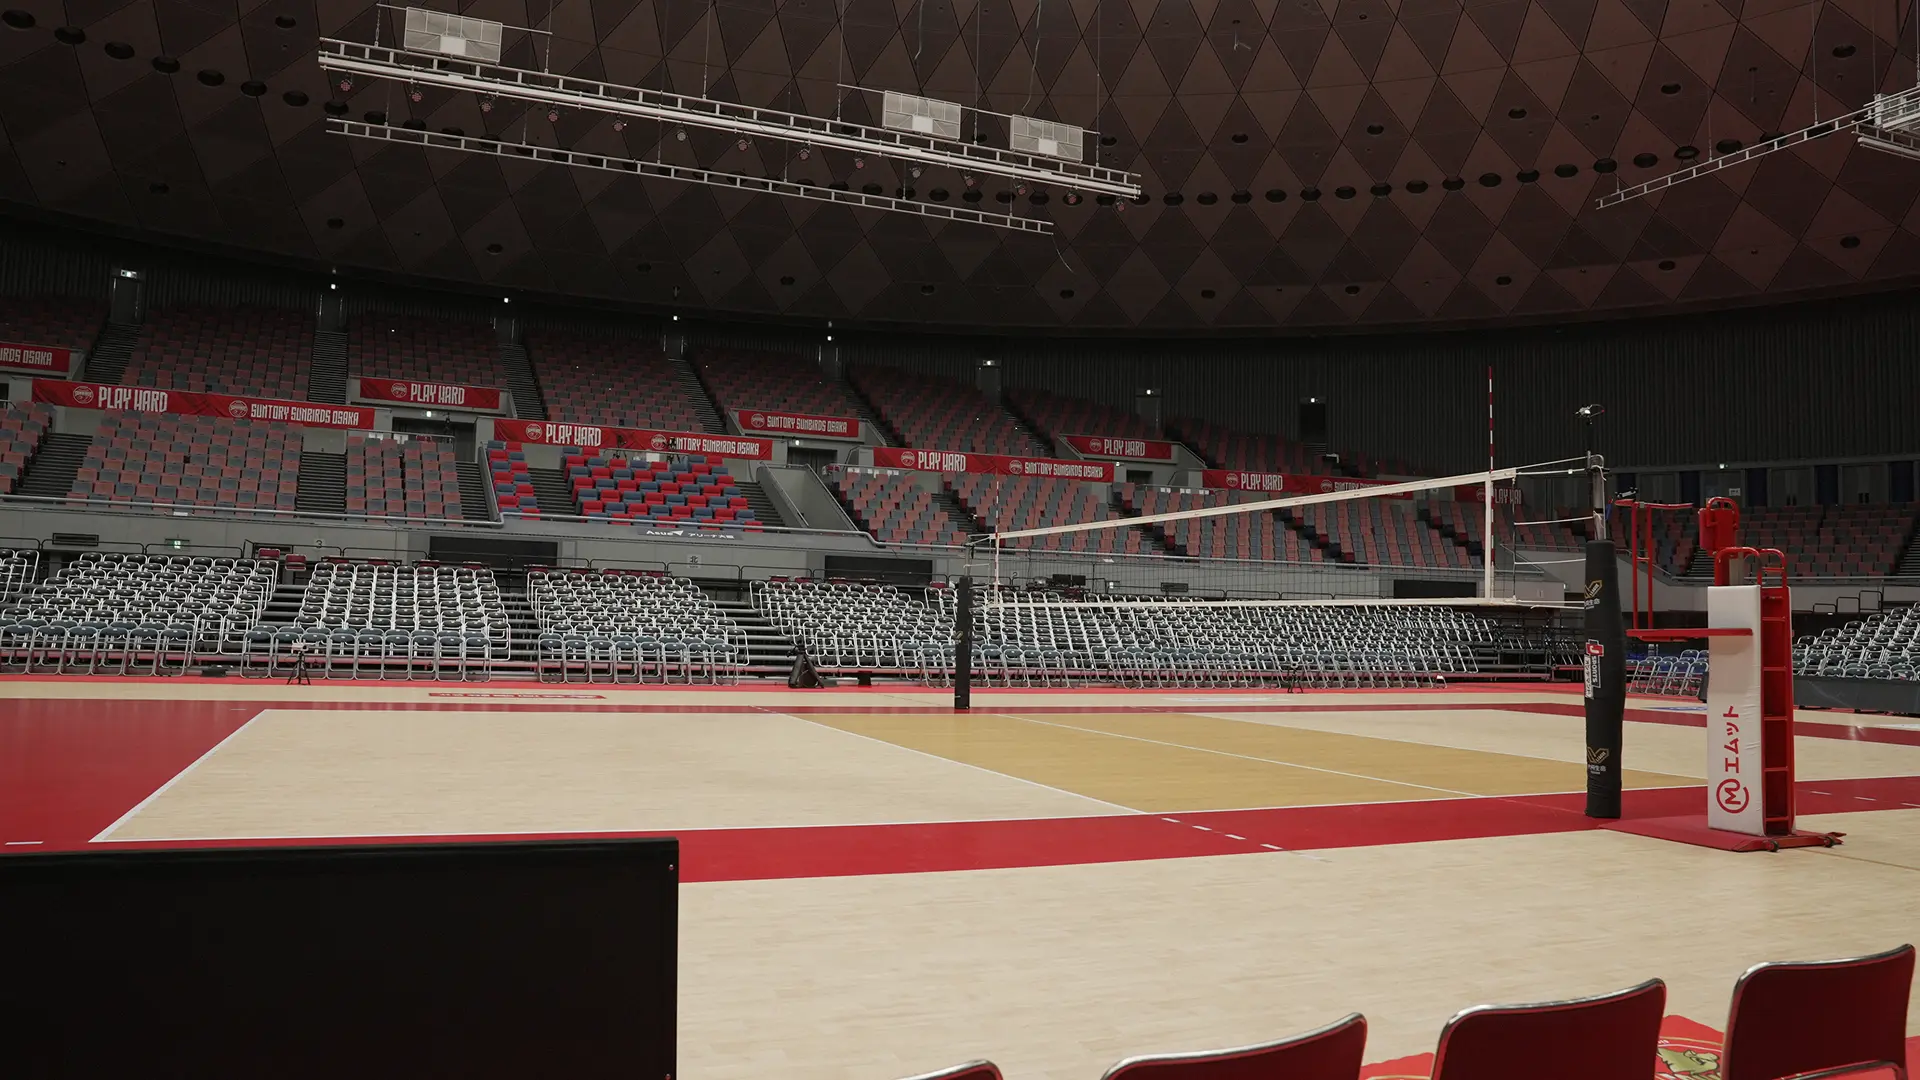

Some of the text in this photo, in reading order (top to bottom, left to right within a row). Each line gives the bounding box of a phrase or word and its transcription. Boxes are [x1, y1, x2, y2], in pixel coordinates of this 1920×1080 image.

[23, 350, 53, 366] OSAKA
[98, 386, 169, 412] PLAY HARD
[410, 383, 465, 405] PLAY HARD
[251, 403, 290, 420] SUNTORY
[291, 406, 331, 423] SUNBIRDS
[332, 411, 359, 426] OSAKA
[766, 416, 796, 429] SUNTORY
[796, 417, 827, 431] SUNBIRDS
[827, 421, 848, 433] OSAKA
[545, 423, 602, 447] PLAY HARD
[702, 439, 737, 453] SUNBIRDS
[737, 443, 760, 455] OSAKA
[1104, 439, 1146, 457] PLAY HARD
[918, 451, 967, 472] PLAY HARD
[1024, 462, 1053, 475] SUNTORY
[1053, 464, 1083, 477] SUNBIRDS
[1083, 466, 1104, 478] OSAKA
[1241, 473, 1283, 491] PLAY HARD
[1493, 488, 1509, 504] LAY
[1722, 705, 1740, 774] エムット
